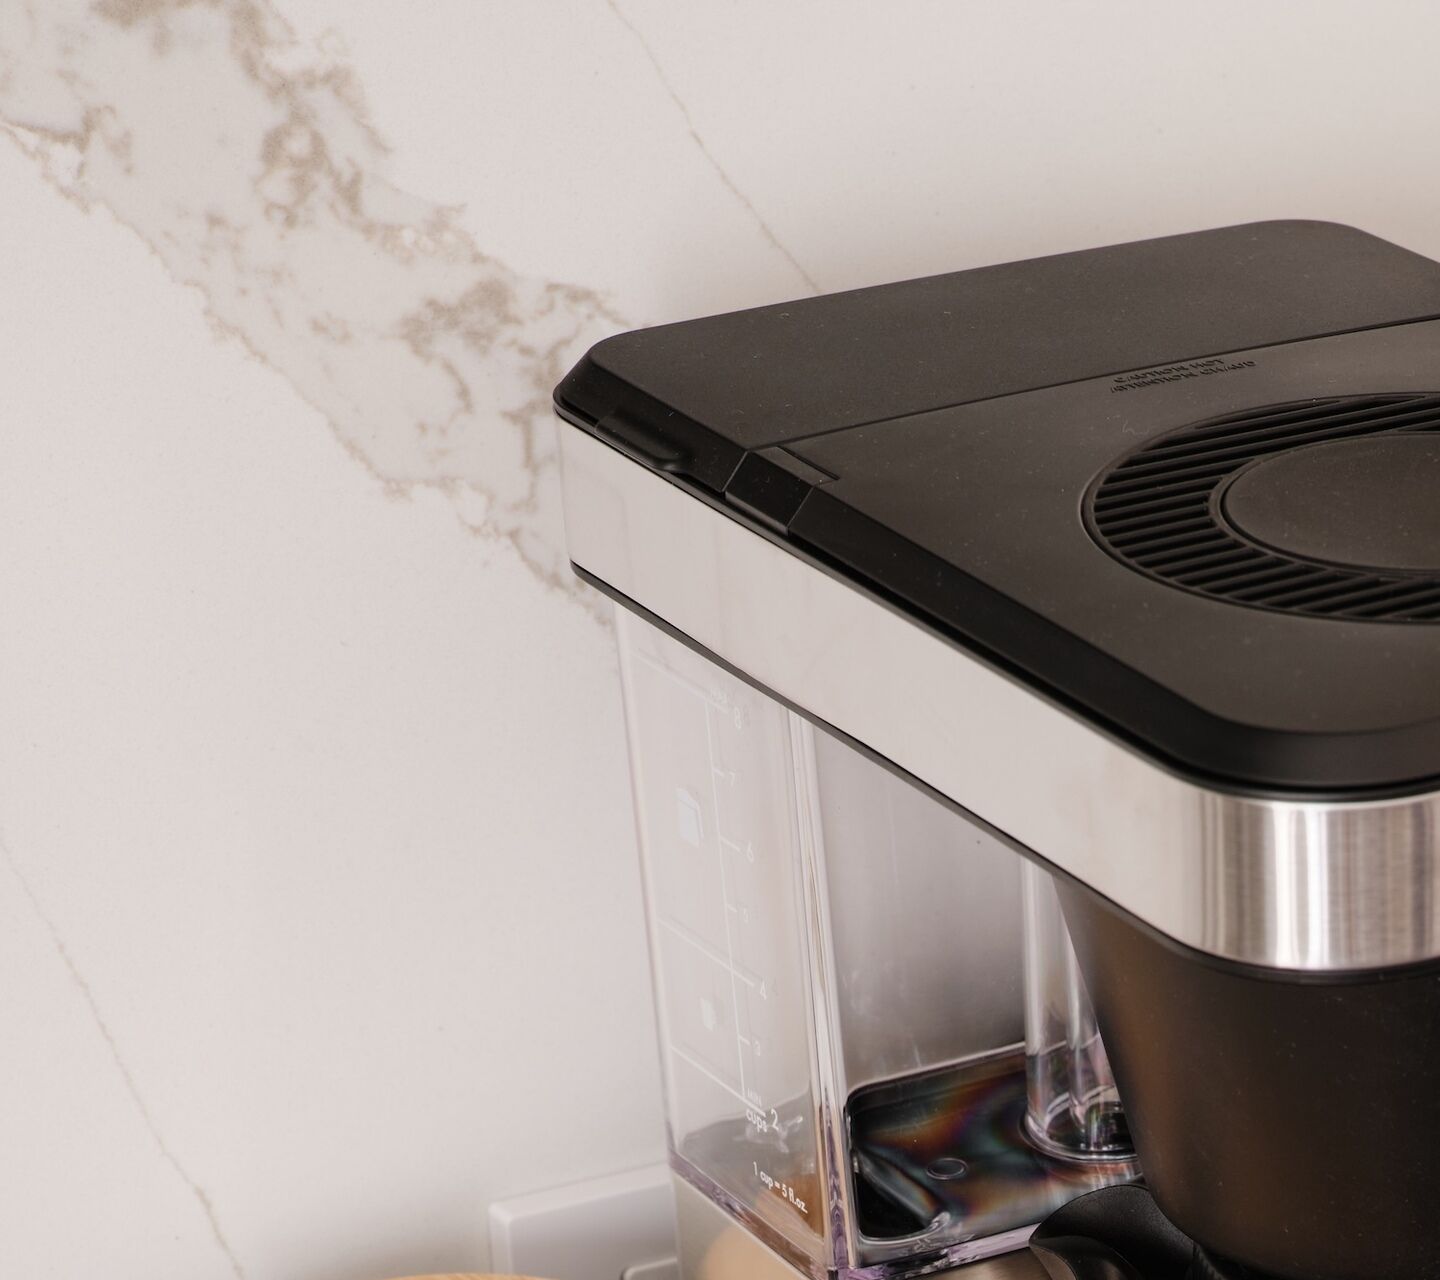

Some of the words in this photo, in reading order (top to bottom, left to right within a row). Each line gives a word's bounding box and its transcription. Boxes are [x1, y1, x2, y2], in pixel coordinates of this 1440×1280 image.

[1110, 371, 1199, 394] ATTENTION
[1200, 360, 1257, 377] CHAUD
[1113, 364, 1189, 384] CAUTION
[1190, 358, 1225, 370] HOT
[746, 840, 755, 863] 6
[759, 979, 767, 1001] 4
[746, 1109, 767, 1133] cups
[771, 1108, 779, 1131] 2
[752, 1160, 758, 1176] 1
[759, 1170, 774, 1190] cup
[781, 1183, 788, 1198] 5
